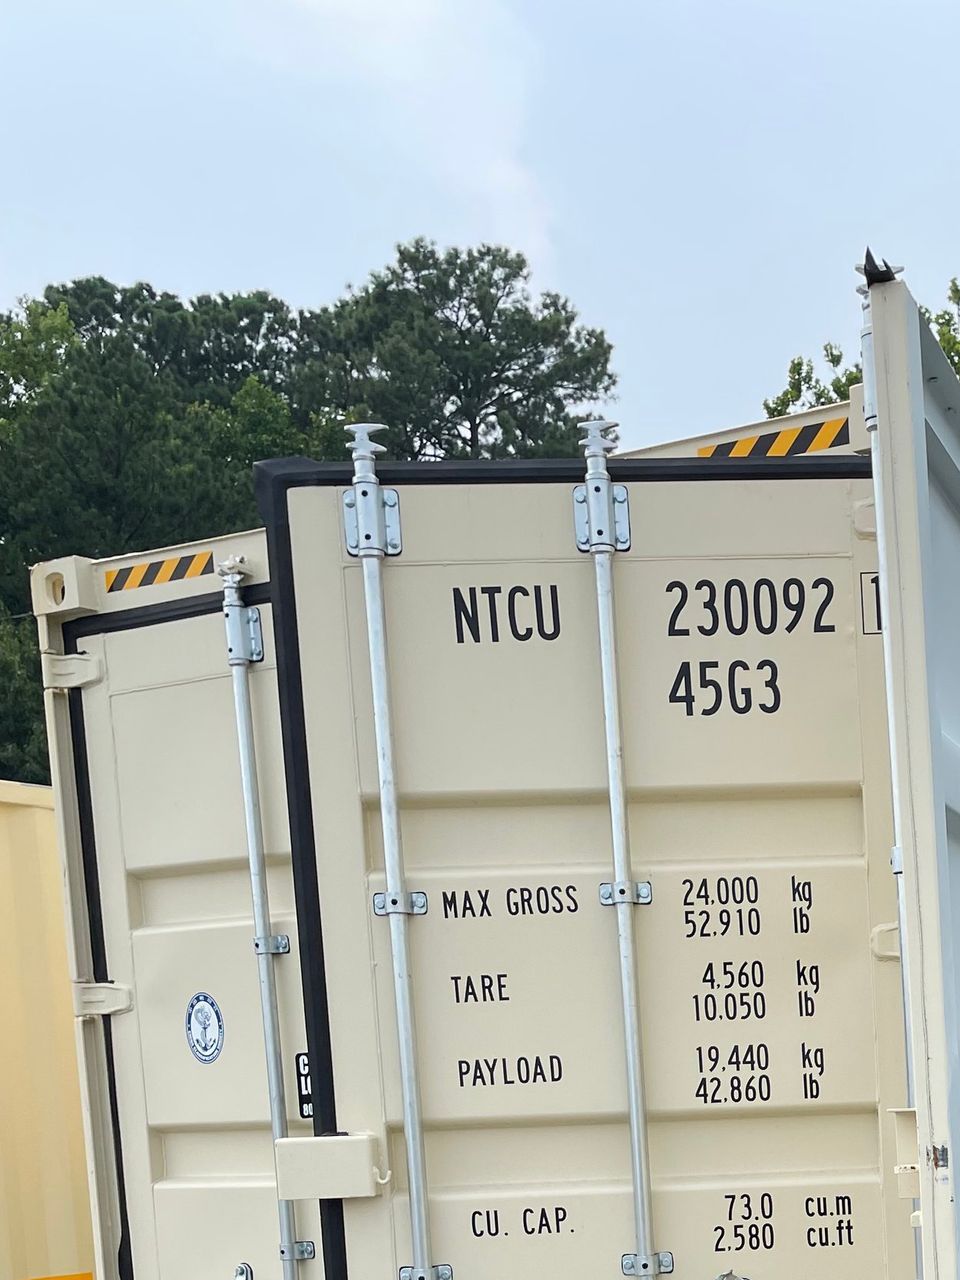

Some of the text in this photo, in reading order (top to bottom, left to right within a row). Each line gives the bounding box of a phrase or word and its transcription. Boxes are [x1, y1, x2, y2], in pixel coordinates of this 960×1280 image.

[453, 585, 561, 643] NTCU
[666, 577, 836, 637] 230092
[669, 659, 781, 717] 45G3
[442, 889, 491, 919] MAX
[507, 886, 579, 915] GROSS
[791, 875, 813, 910] kg
[793, 908, 810, 934] lb
[451, 973, 510, 1003] TARE
[796, 959, 820, 994] kg
[798, 991, 815, 1017] lb
[458, 1055, 563, 1087] PAYLOAD
[801, 1042, 825, 1077] kg
[803, 1073, 820, 1099] lb
[471, 1192, 852, 1237] CU. CAP. 73.0 cu.m
[806, 1219, 854, 1247] cu.ft
